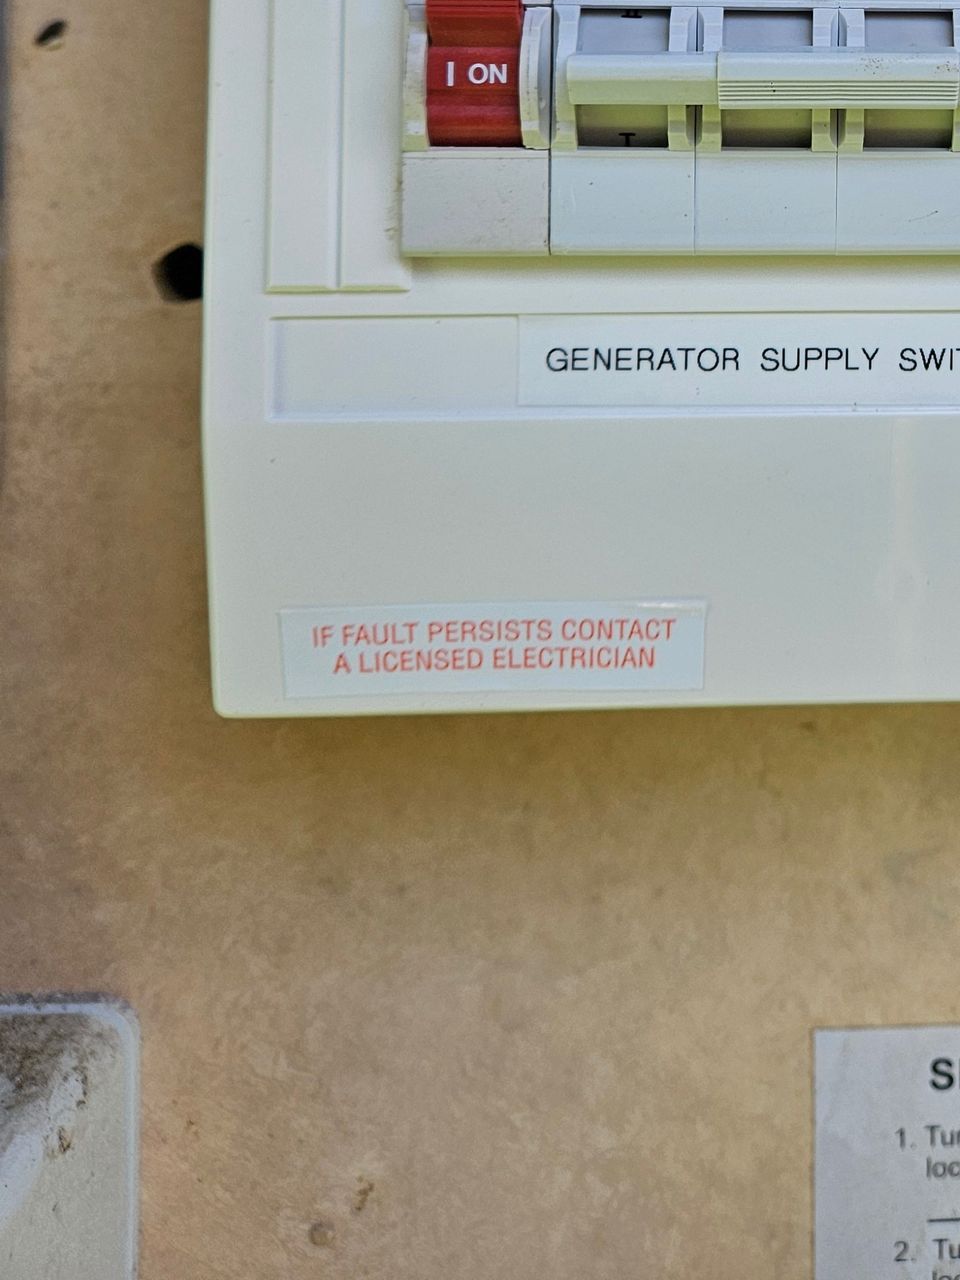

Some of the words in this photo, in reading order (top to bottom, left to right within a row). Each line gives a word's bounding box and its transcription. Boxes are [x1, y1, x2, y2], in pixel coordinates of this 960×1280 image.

[468, 62, 508, 84] ON
[546, 347, 740, 372] GENERATOR
[760, 347, 880, 372] SUPPLY
[311, 625, 332, 646] IF
[341, 622, 416, 646] FAULT
[427, 619, 553, 644] PERSISTS
[560, 617, 674, 642] CONTACT
[332, 655, 352, 674] A
[358, 647, 484, 673] LICENSED
[492, 646, 656, 670] ELECTRICIAN
[895, 1127, 917, 1149] 1.
[893, 1240, 917, 1263] 2.
